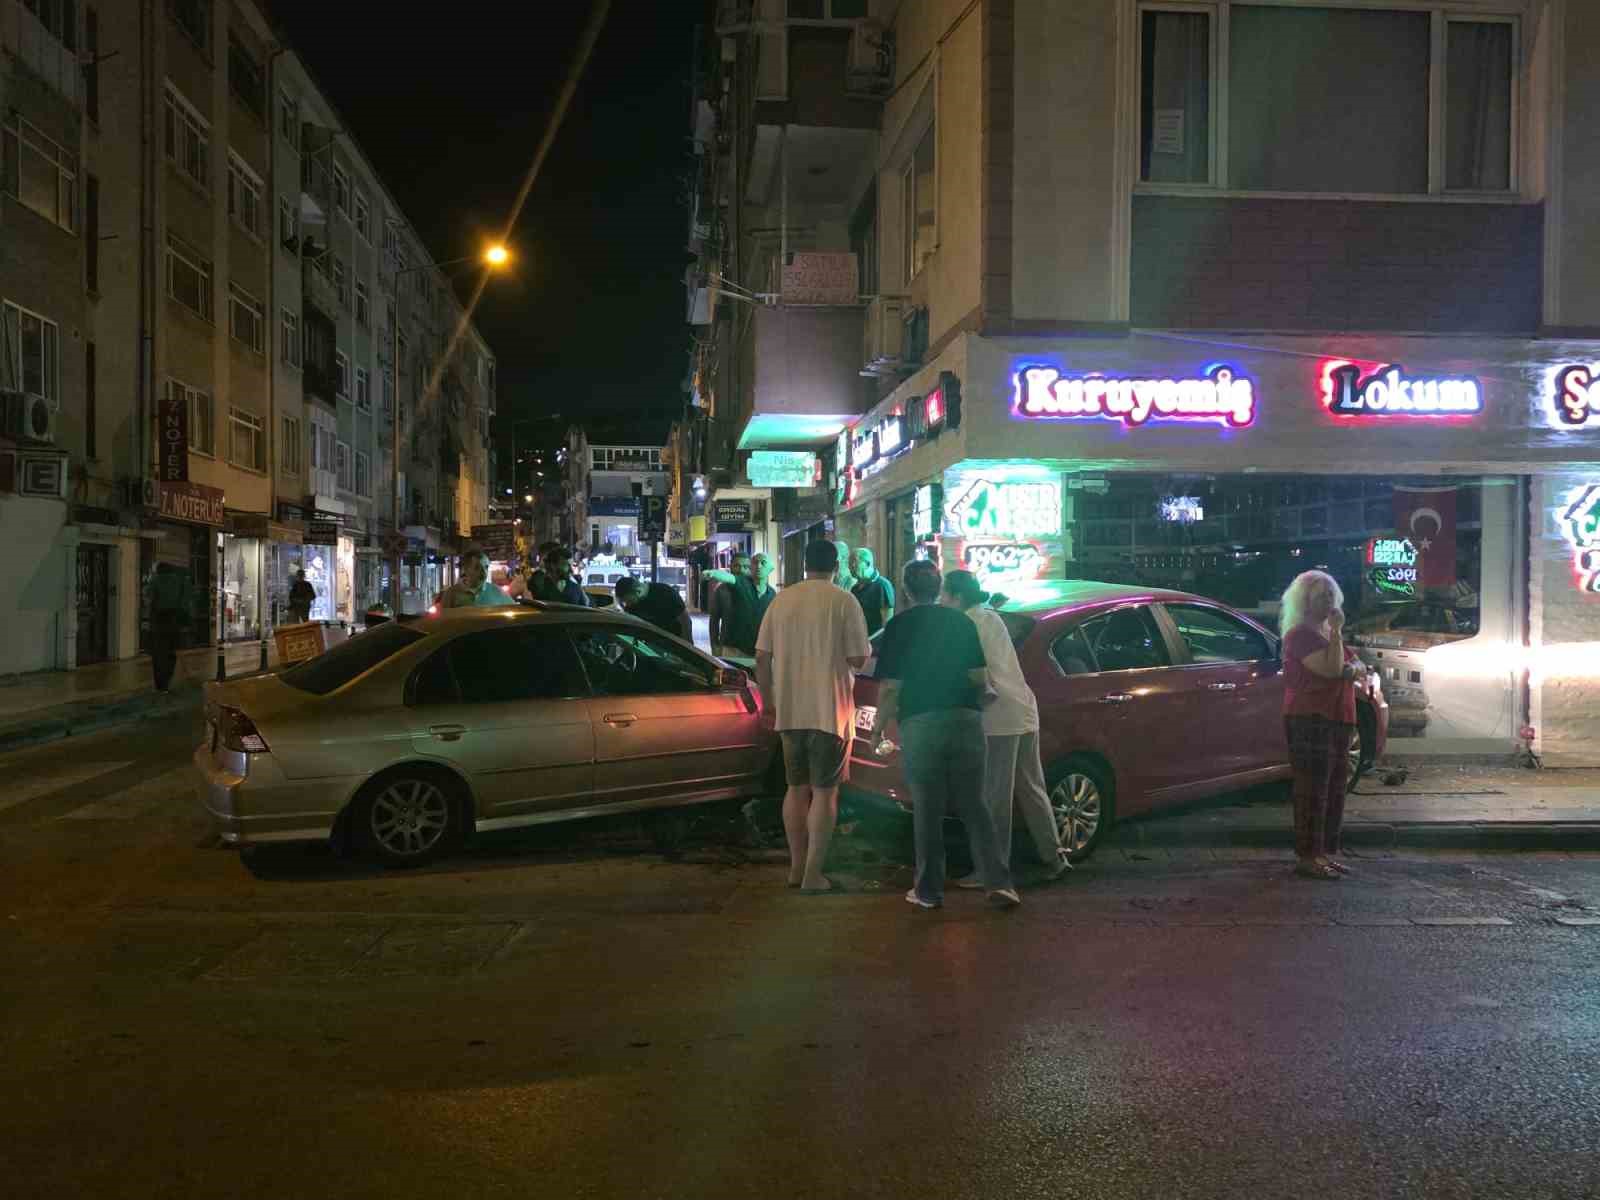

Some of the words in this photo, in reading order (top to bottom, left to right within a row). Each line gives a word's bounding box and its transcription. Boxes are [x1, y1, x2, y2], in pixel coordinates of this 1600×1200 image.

[1024, 367, 1251, 423] Kuruyemiş
[1340, 369, 1479, 409] Lokum
[166, 416, 181, 481] NOTER
[969, 546, 1020, 569] 1962
